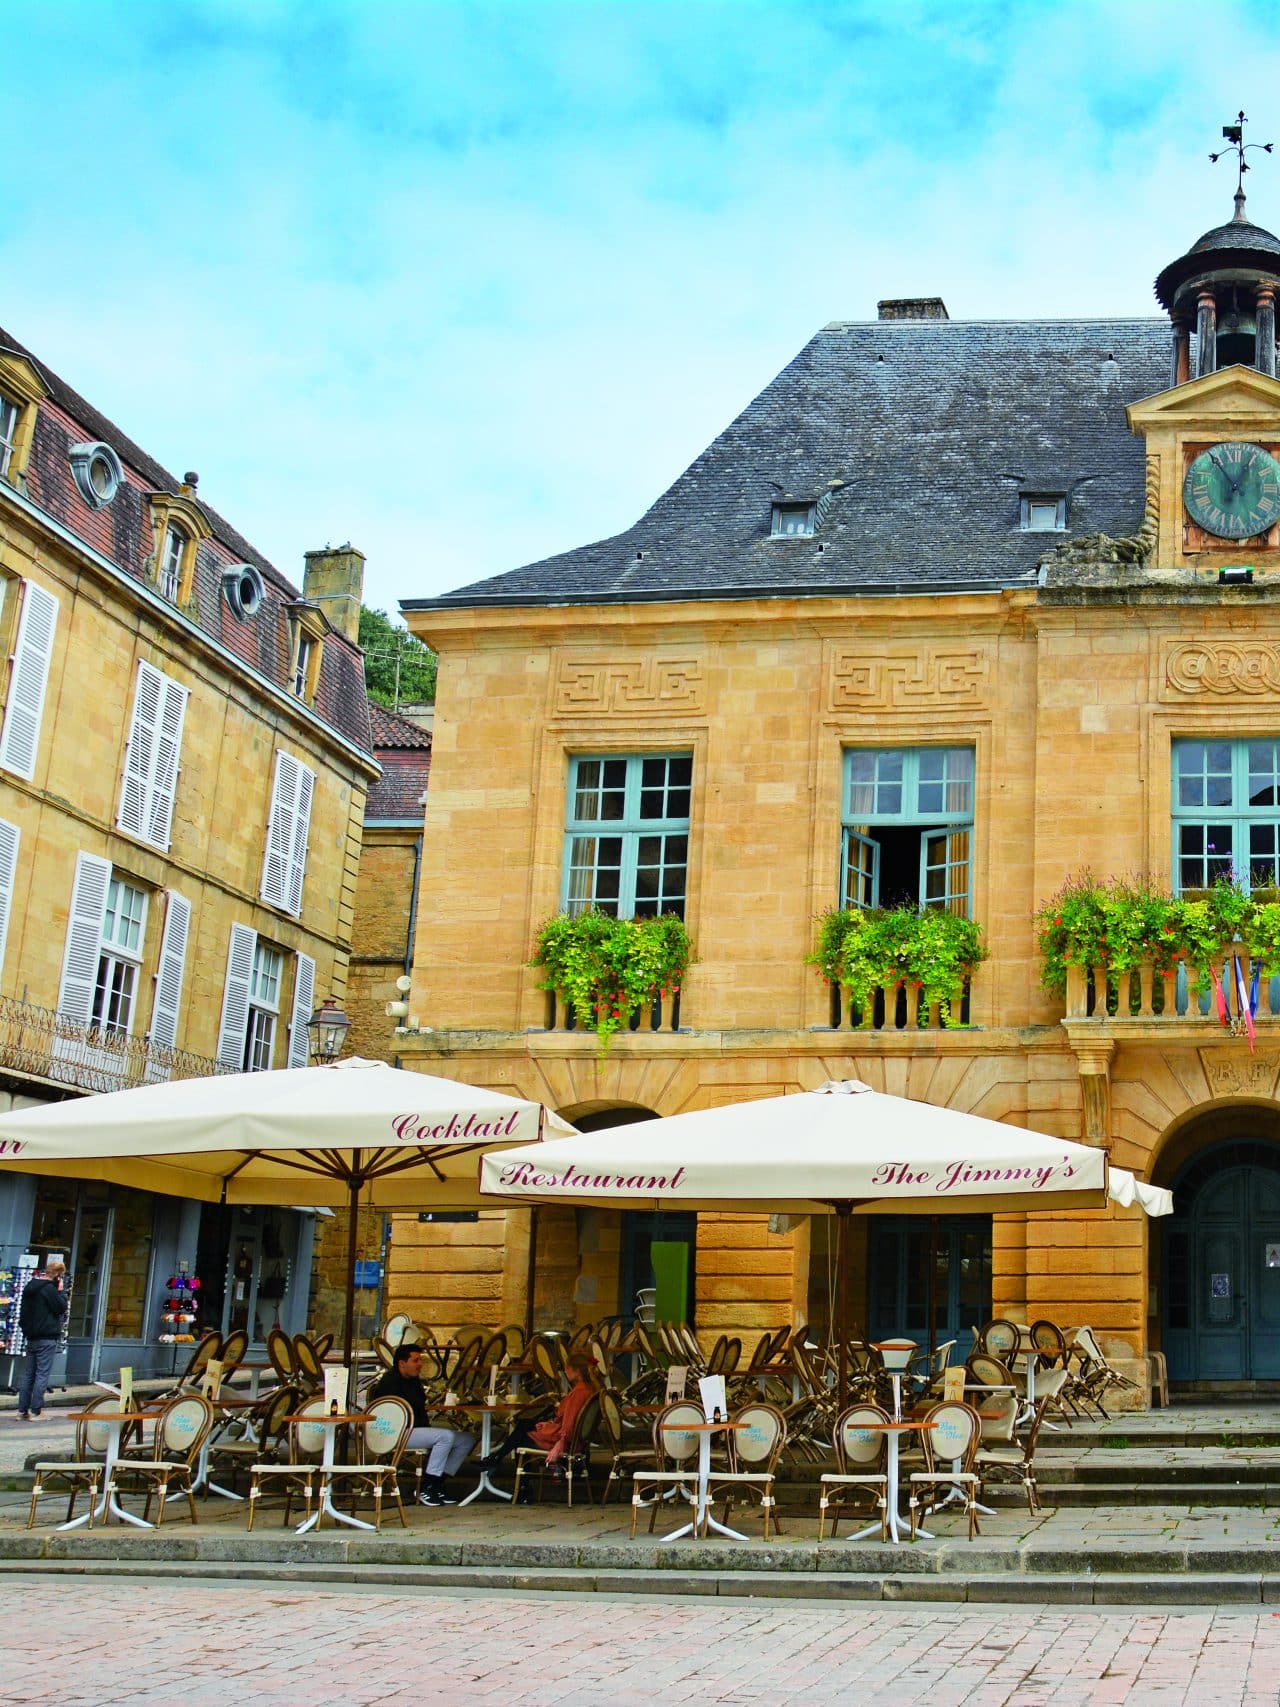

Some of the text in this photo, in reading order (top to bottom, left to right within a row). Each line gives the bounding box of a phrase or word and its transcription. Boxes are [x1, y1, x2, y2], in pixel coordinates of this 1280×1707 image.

[1216, 1060, 1234, 1081] R
[391, 1110, 520, 1141] Cocktail
[499, 1161, 687, 1190] Restaurant
[871, 1155, 1081, 1192] The Jimmy's
